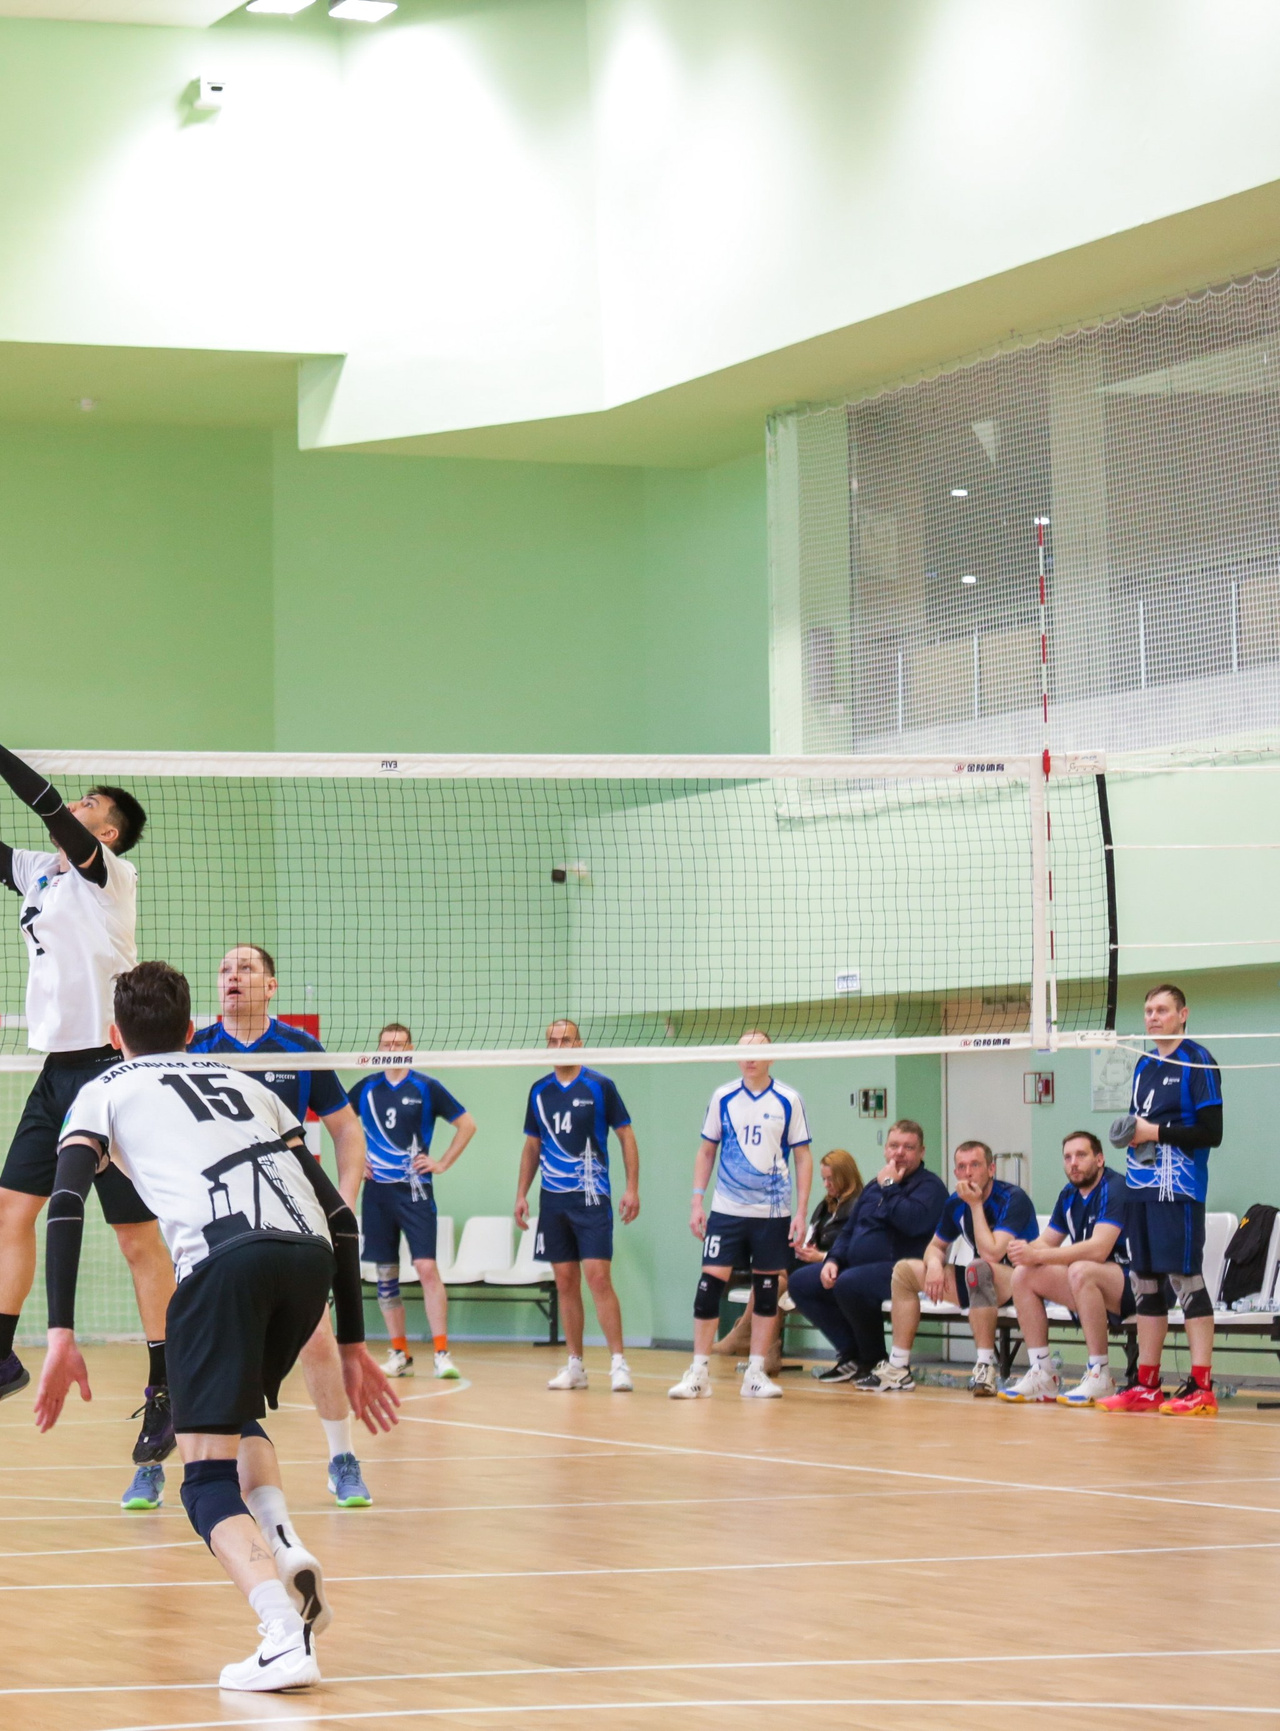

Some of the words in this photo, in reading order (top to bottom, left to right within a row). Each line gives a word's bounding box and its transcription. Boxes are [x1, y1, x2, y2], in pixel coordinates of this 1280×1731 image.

[100, 1062, 189, 1084] ЗАПАДНАЯ
[157, 1073, 255, 1123] 15
[385, 1107, 397, 1129] 3
[552, 1110, 572, 1135] 14
[744, 1124, 762, 1146] 15
[703, 1234, 721, 1258] 15
